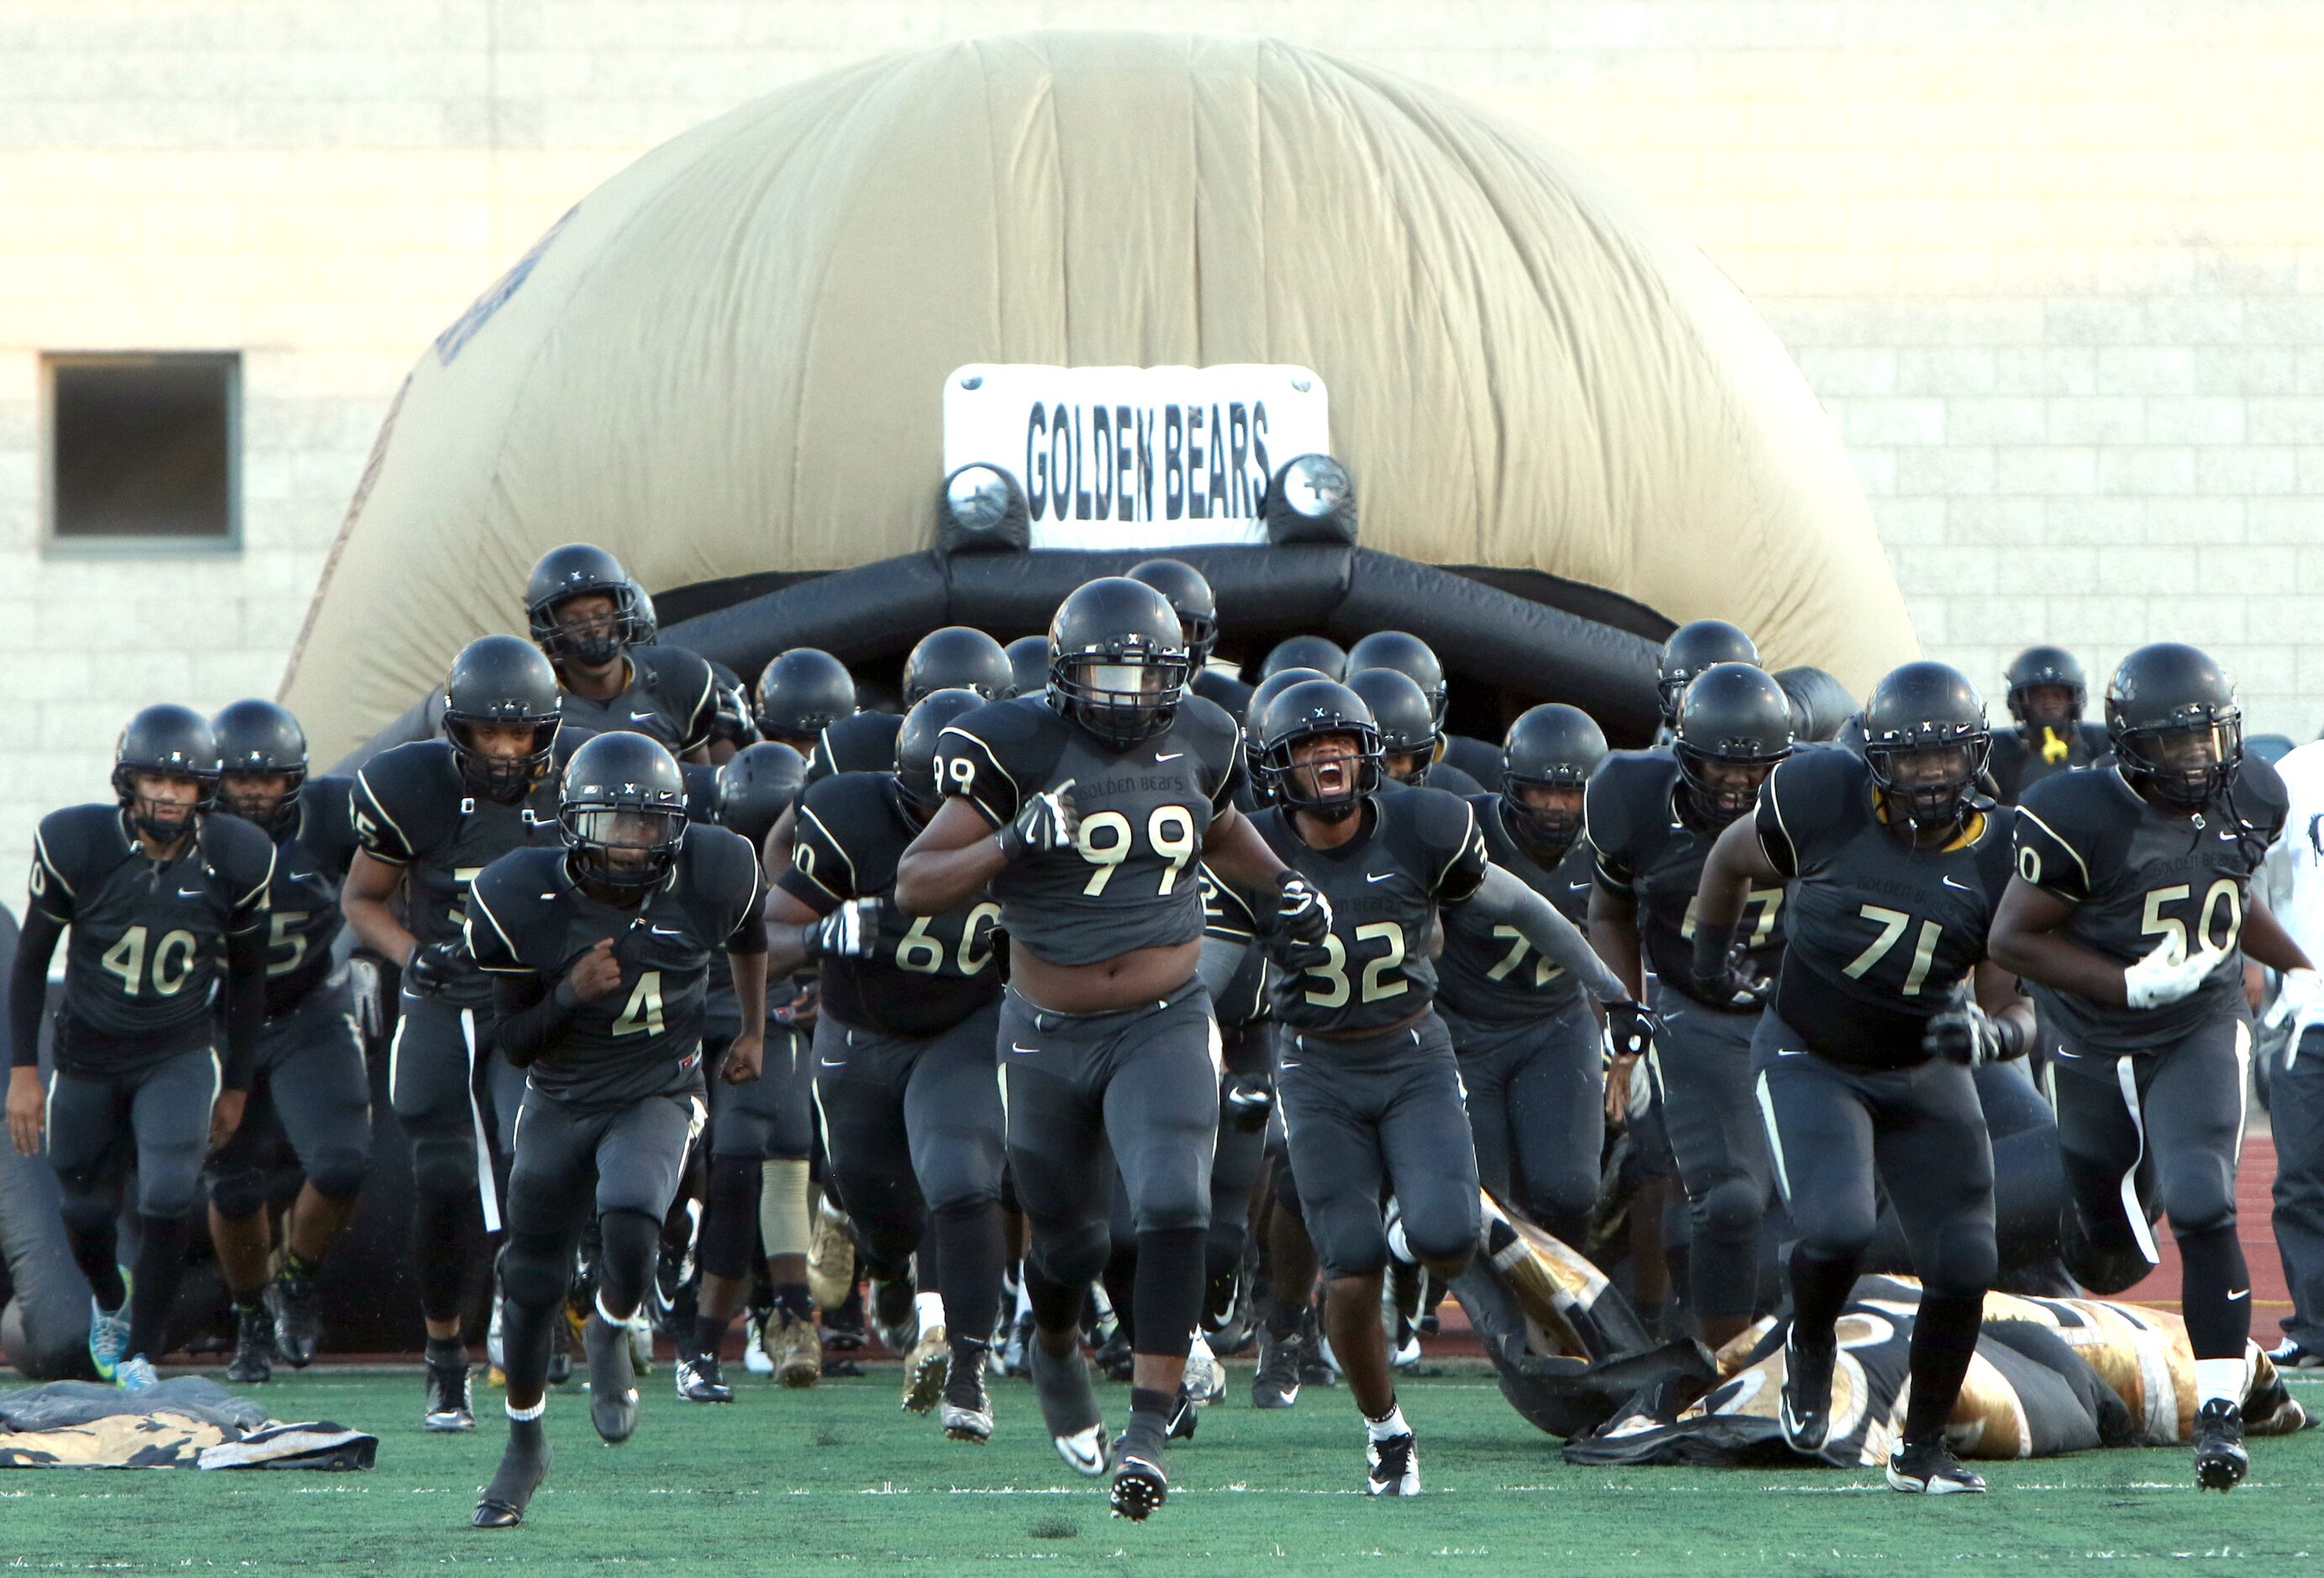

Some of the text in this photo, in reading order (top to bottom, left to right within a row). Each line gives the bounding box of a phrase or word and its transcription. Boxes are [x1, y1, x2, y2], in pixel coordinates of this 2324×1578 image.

[1026, 400, 1271, 522] GOLDEN BEARS
[933, 755, 976, 796] 99
[1077, 804, 1194, 897] 99
[102, 925, 197, 997] 40
[895, 902, 1005, 976] 60
[1304, 921, 1409, 1007] 32
[1842, 903, 1943, 996] 71
[2141, 878, 2243, 967] 50
[612, 970, 666, 1037] 4
